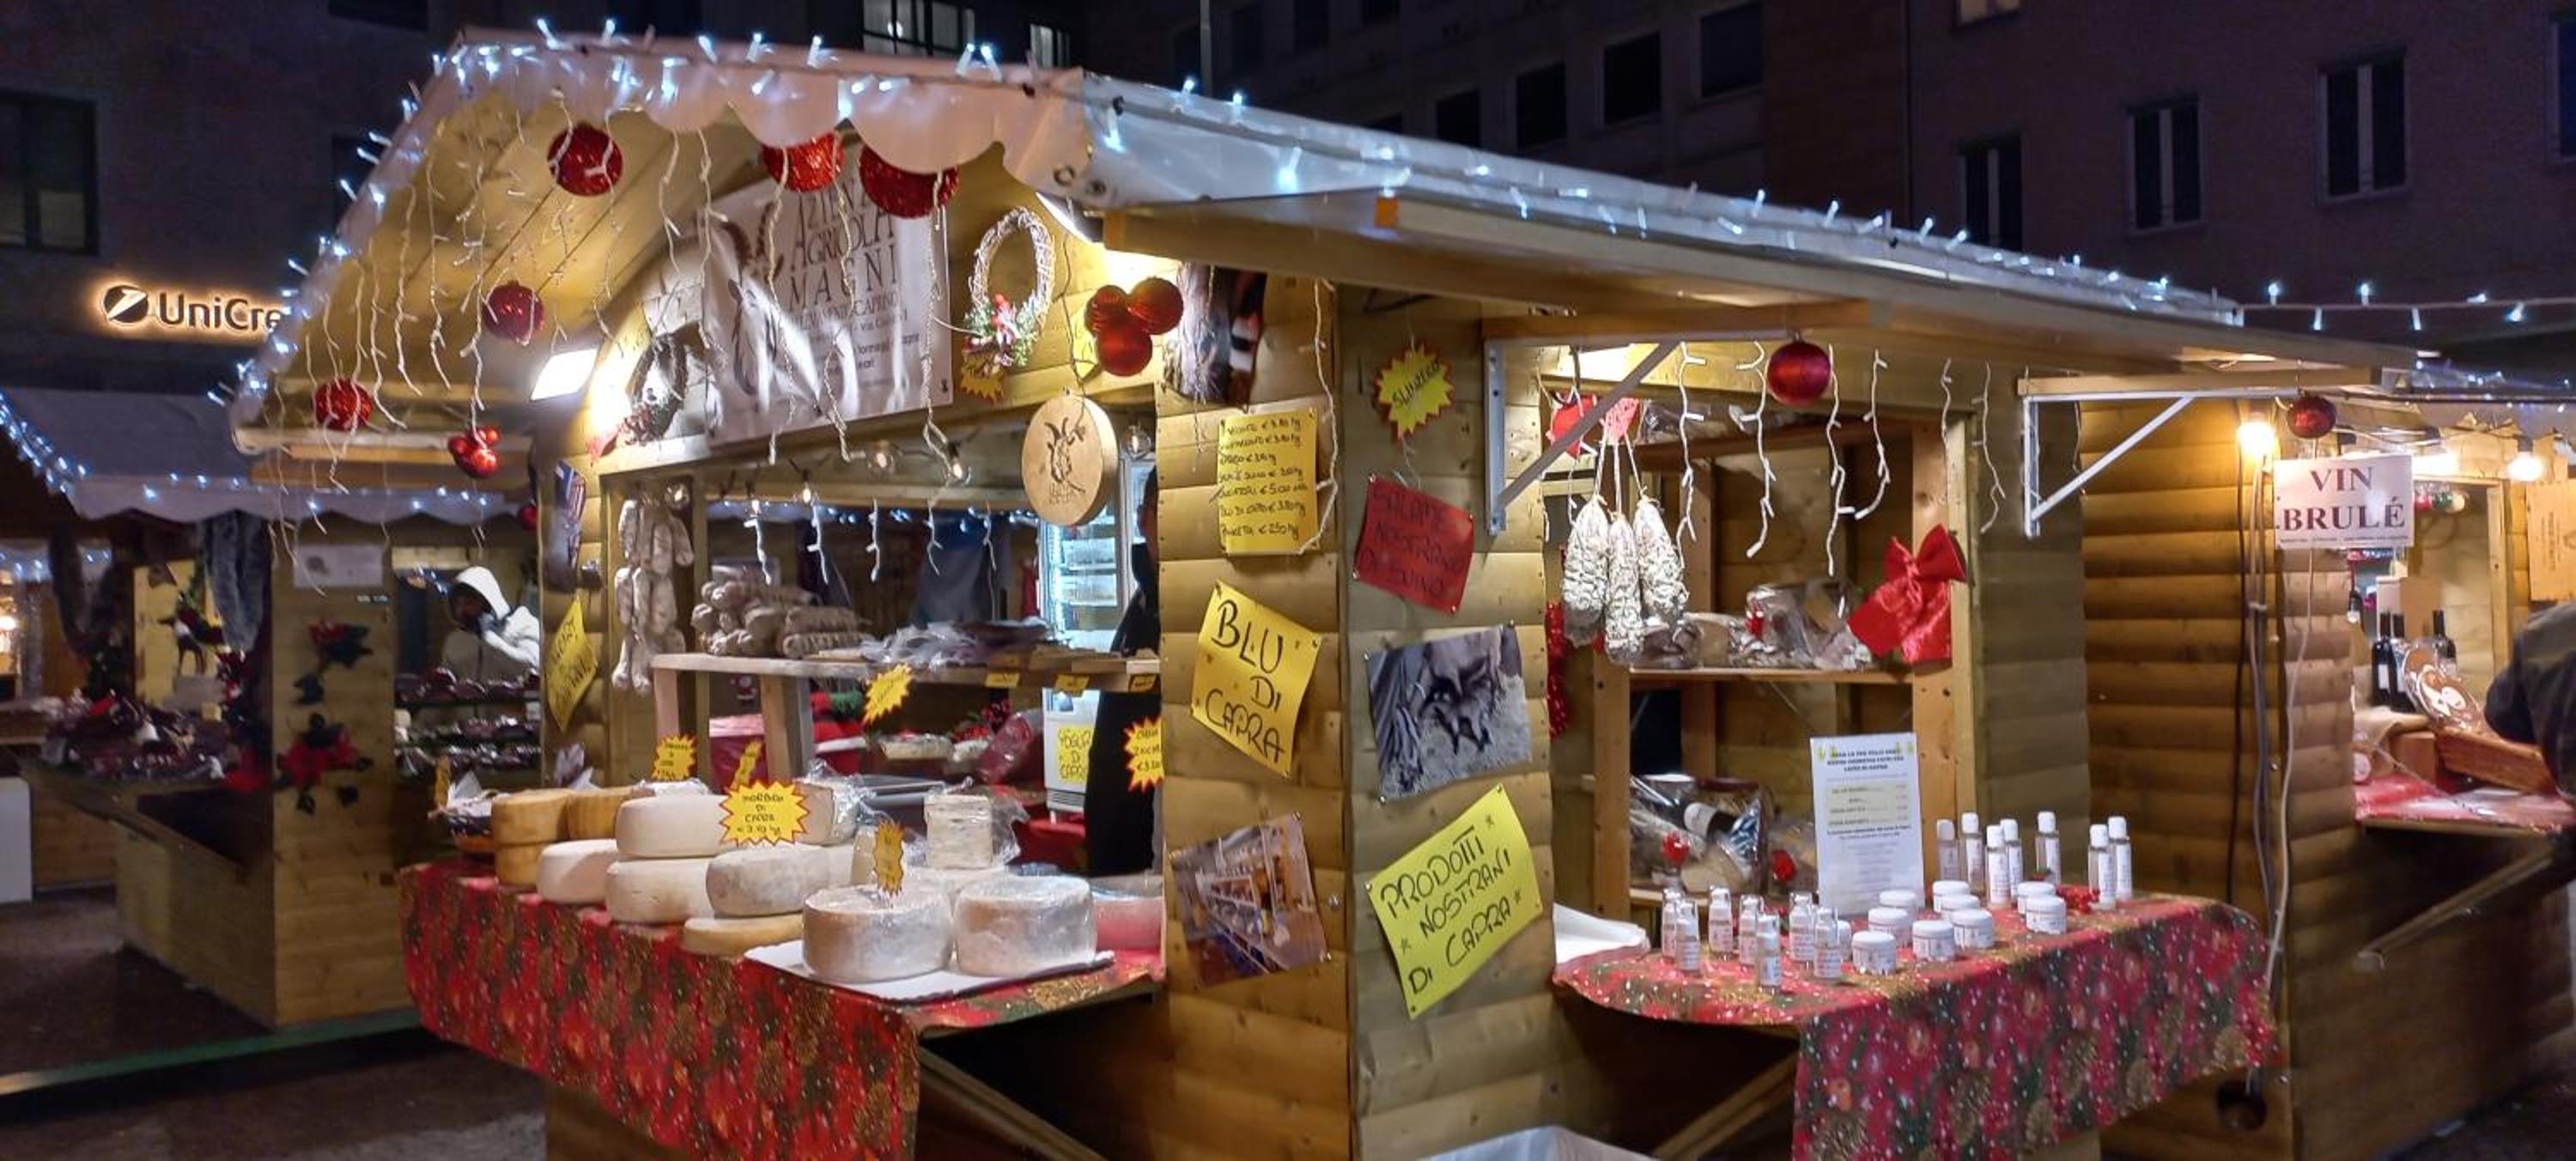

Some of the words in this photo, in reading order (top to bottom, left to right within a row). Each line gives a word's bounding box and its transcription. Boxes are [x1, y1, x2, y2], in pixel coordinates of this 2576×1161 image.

[789, 244, 898, 311] MAGNI
[2283, 495, 2405, 532] BRULÉ
[2311, 466, 2373, 492] VIN
[1210, 599, 1284, 674] BLU
[1205, 688, 1286, 763] CAPRA
[1249, 676, 1282, 713] DI
[1380, 824, 1485, 919] PRODOTTI
[1419, 848, 1511, 938] NOSTRANI
[1408, 967, 1433, 994] DI
[1445, 896, 1512, 969] CAPRA
